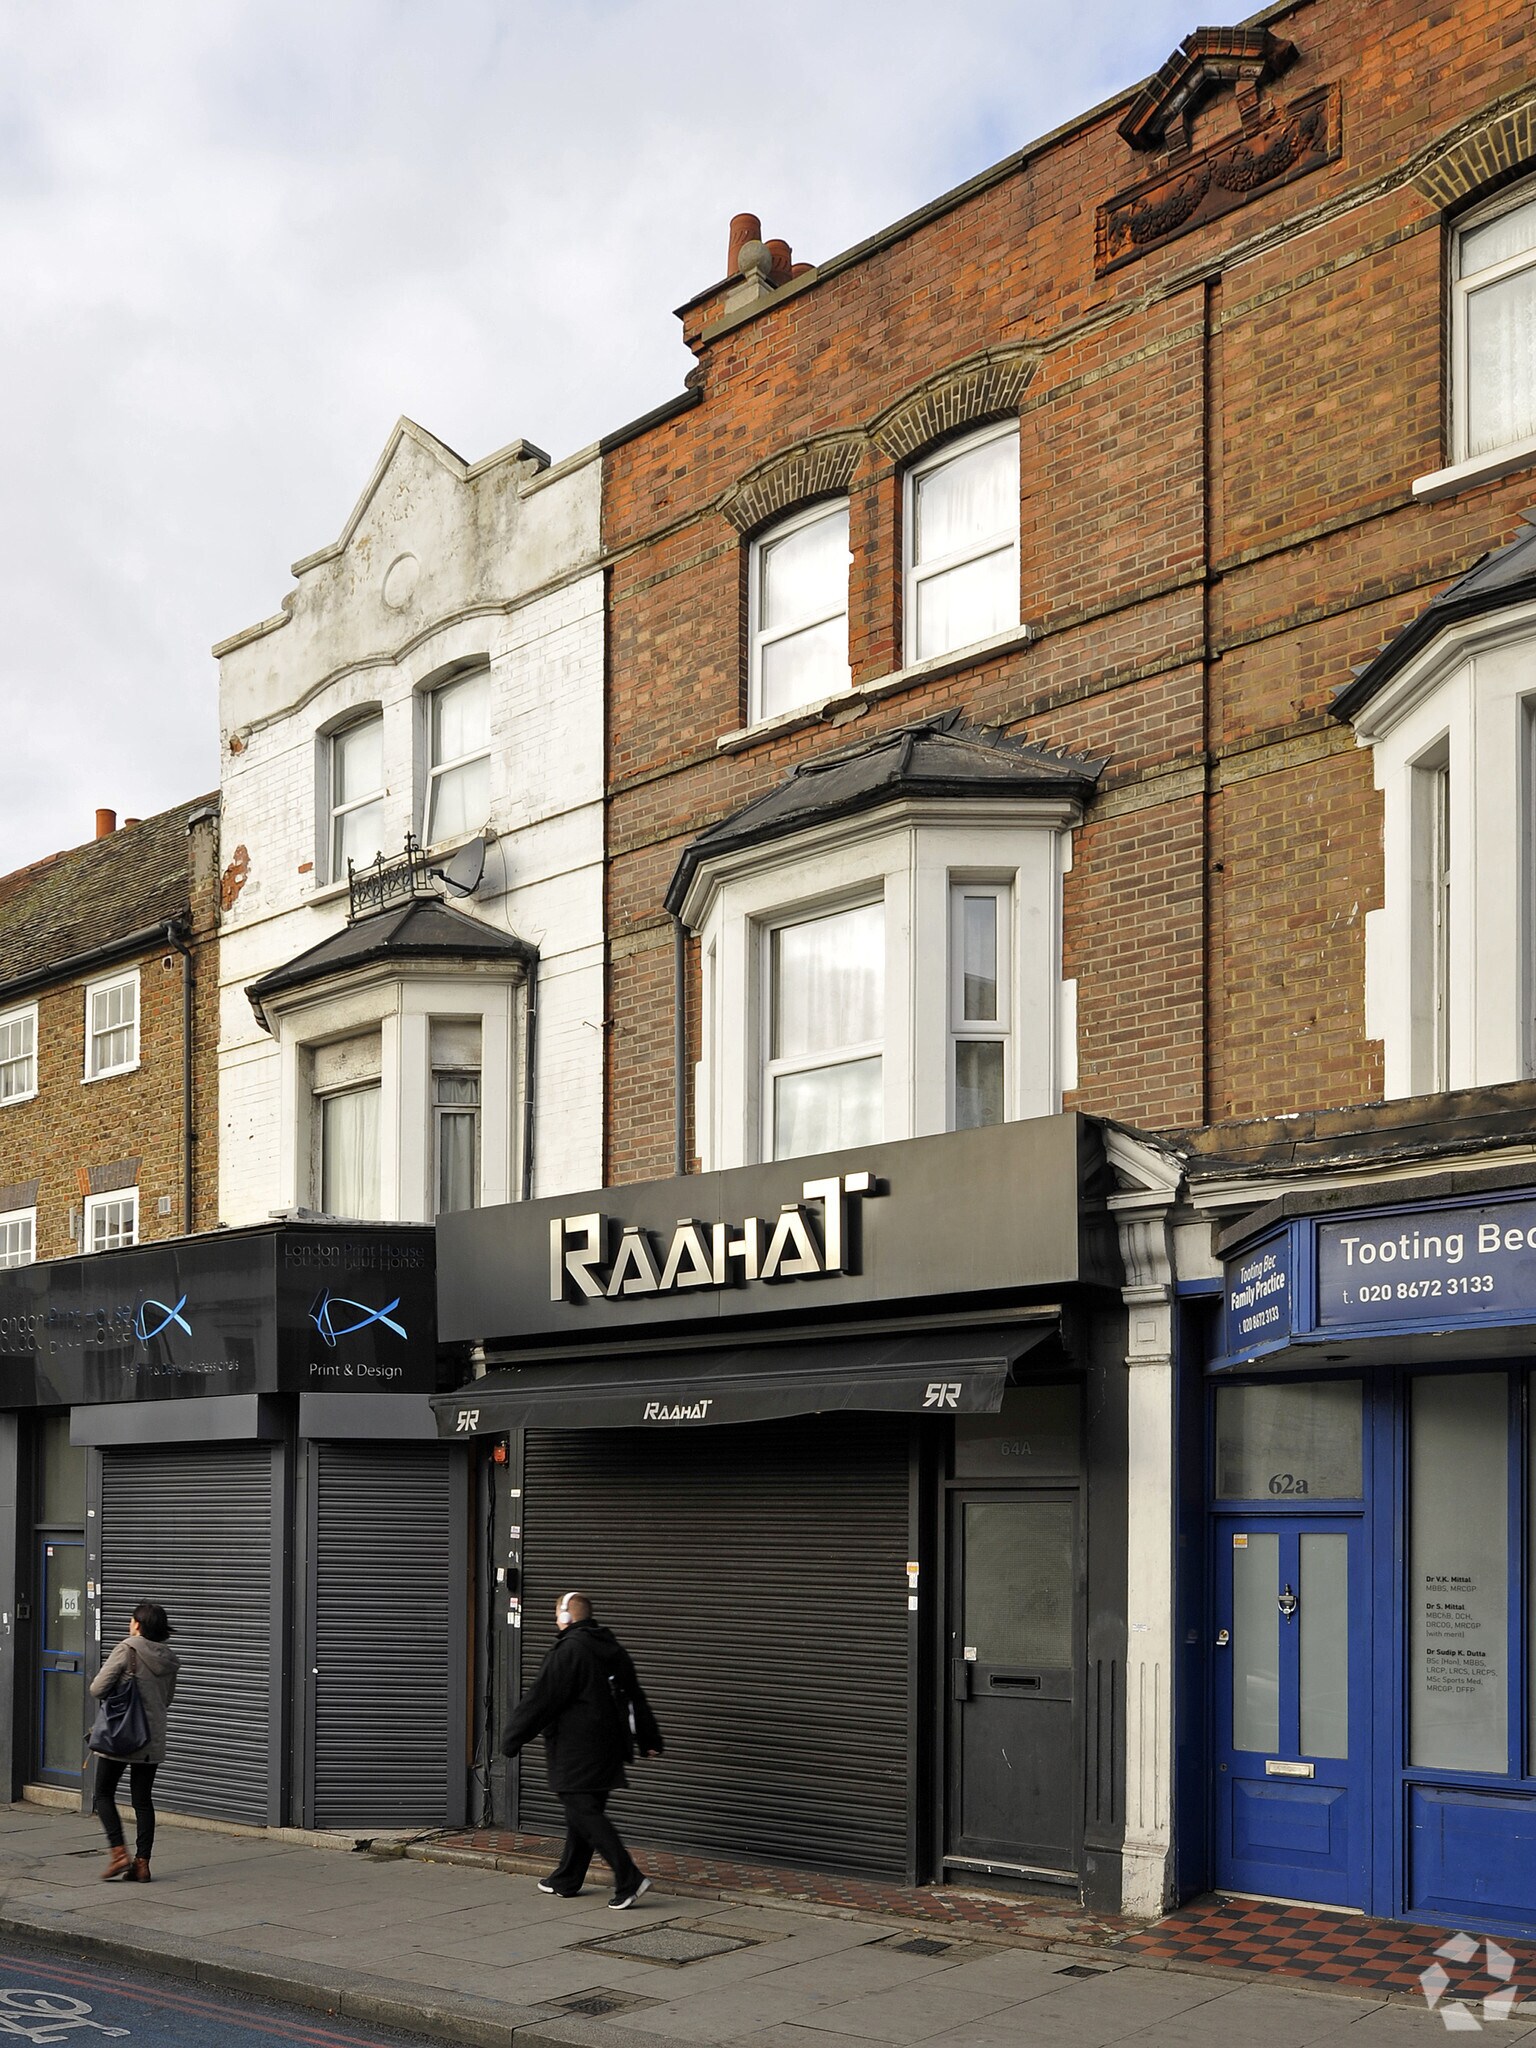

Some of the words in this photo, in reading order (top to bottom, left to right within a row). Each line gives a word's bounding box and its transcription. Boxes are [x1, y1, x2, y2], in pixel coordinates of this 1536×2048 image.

[549, 1171, 875, 1302] RAAHAT
[1340, 1231, 1464, 1265] Tooting
[284, 1243, 340, 1257] London
[380, 1244, 424, 1259] House
[1240, 1261, 1263, 1284] Tooting
[1263, 1254, 1276, 1273] Bec
[1231, 1285, 1255, 1311] Family
[1255, 1271, 1285, 1301] Practice
[1342, 1290, 1354, 1304] t.
[1359, 1284, 1391, 1303] 020
[1396, 1280, 1441, 1299] 8672
[1447, 1275, 1494, 1295] 3133
[1243, 1317, 1253, 1333] 020
[1253, 1311, 1266, 1329] 8672
[1265, 1305, 1279, 1324] 3133
[309, 1363, 340, 1376] Print
[343, 1363, 354, 1376] &
[357, 1363, 403, 1380] Design
[643, 1399, 713, 1420] RAAHAT
[1000, 1440, 1033, 1456] 64A
[1268, 1473, 1309, 1495] 62a
[64, 1598, 76, 1610] 66
